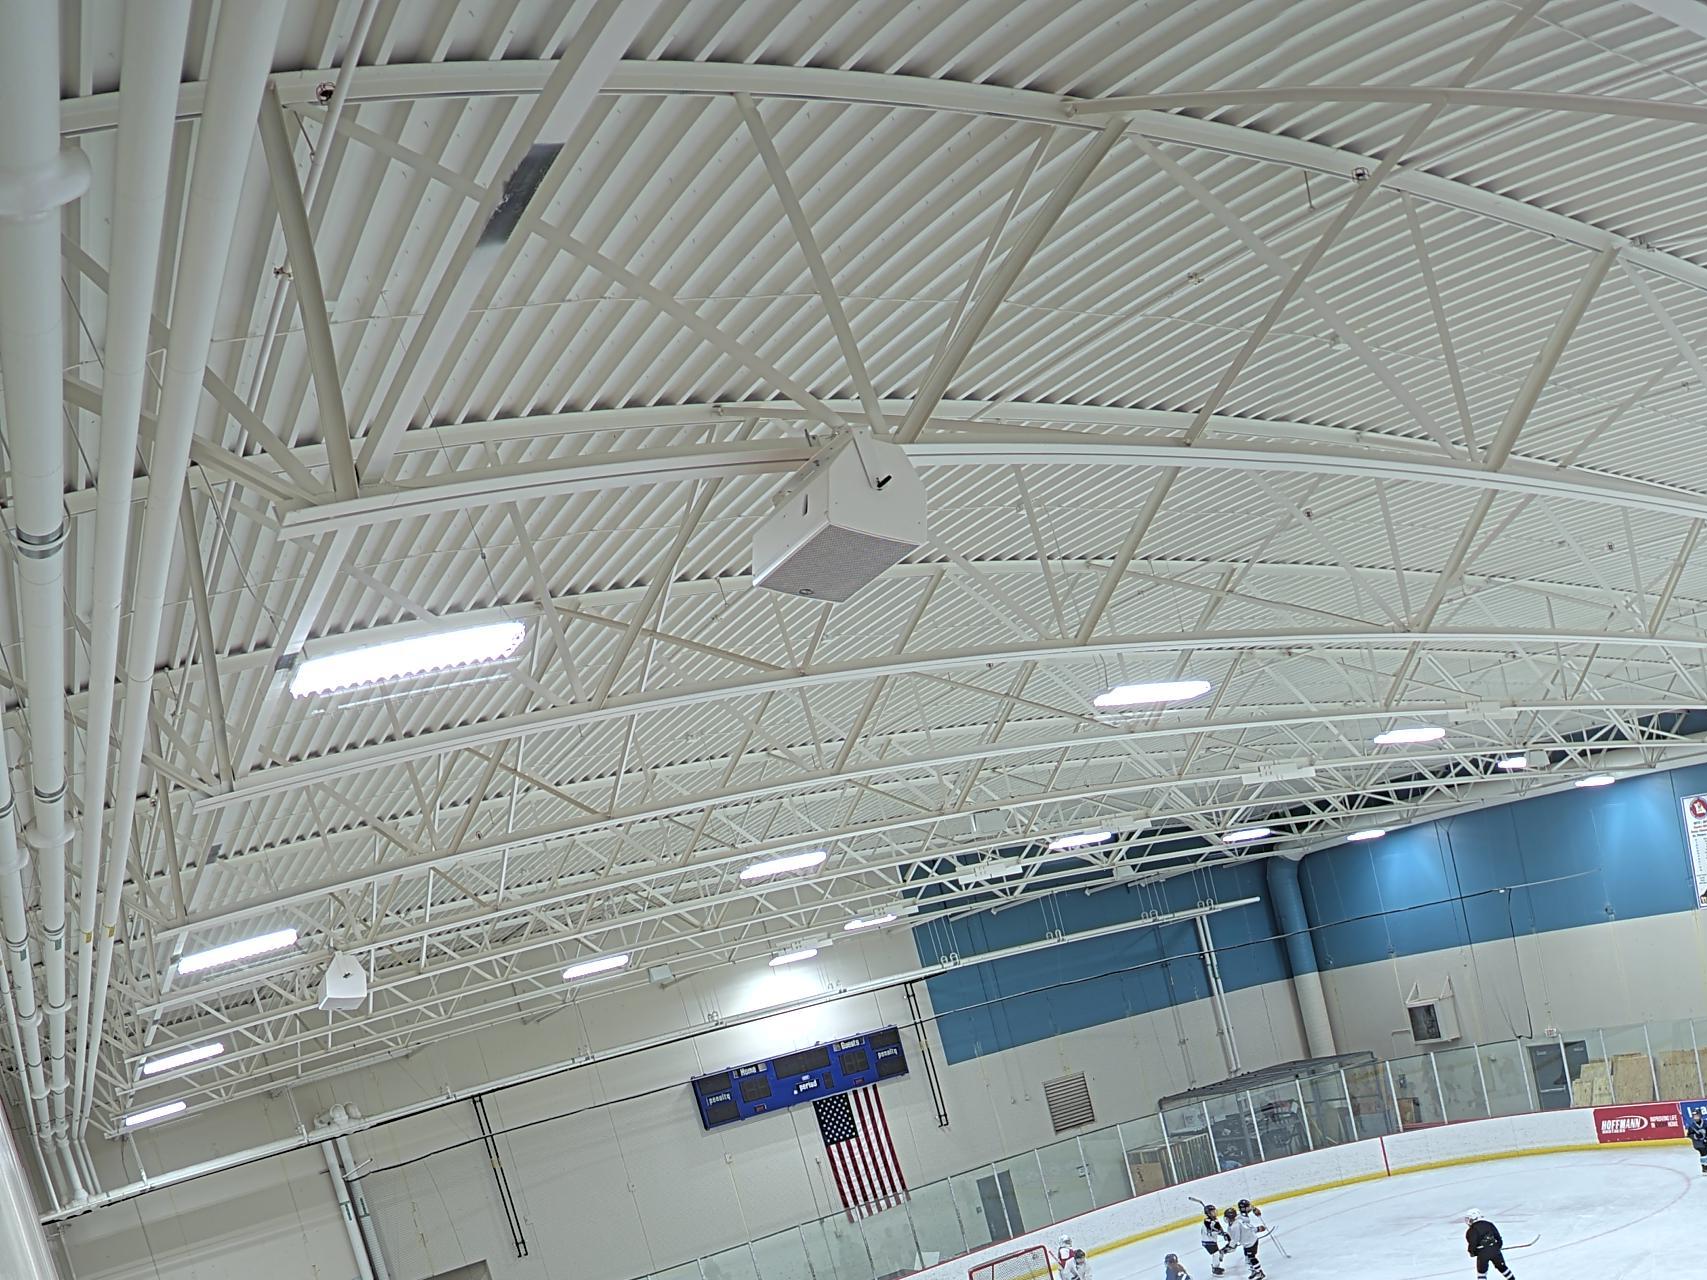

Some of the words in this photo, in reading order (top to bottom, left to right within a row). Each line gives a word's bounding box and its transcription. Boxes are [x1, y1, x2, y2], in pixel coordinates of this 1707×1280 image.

[840, 1039, 859, 1050] Guests
[877, 1047, 898, 1059] penalty
[740, 1066, 756, 1076] Home
[799, 1079, 818, 1092] period
[1601, 1117, 1641, 1130] HOFFMANN
